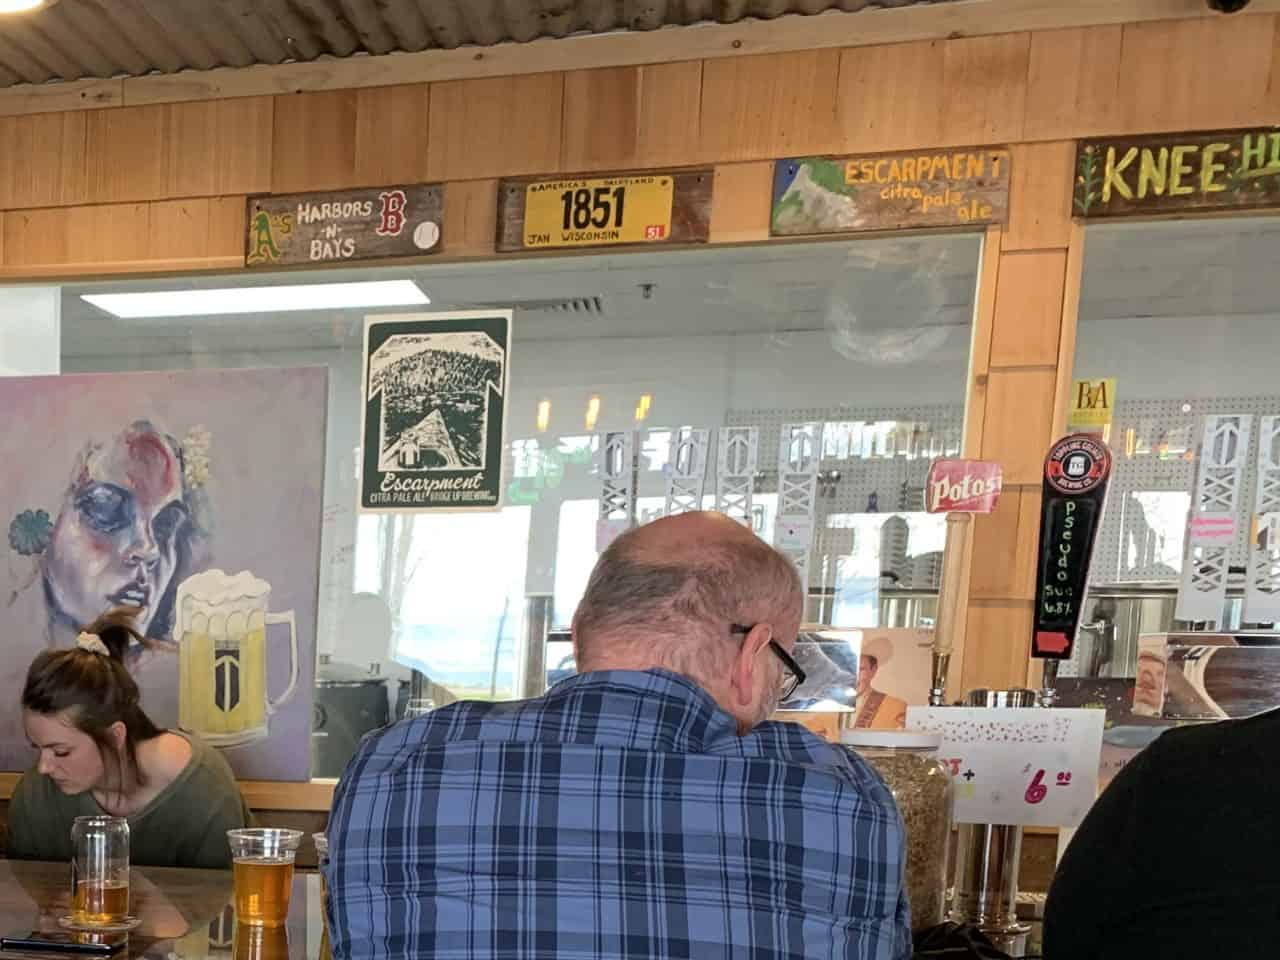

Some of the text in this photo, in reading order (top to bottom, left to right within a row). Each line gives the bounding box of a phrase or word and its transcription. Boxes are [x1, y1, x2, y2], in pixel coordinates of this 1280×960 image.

[845, 150, 1010, 185] ESCARPMENT
[1102, 143, 1231, 203] KNEE
[296, 200, 373, 225] HARBORS
[561, 186, 625, 231] 1851
[957, 199, 993, 220] ale
[309, 238, 356, 262] BAYS
[528, 231, 620, 245] JAN WISCONSIN
[380, 472, 485, 497] Escarpment
